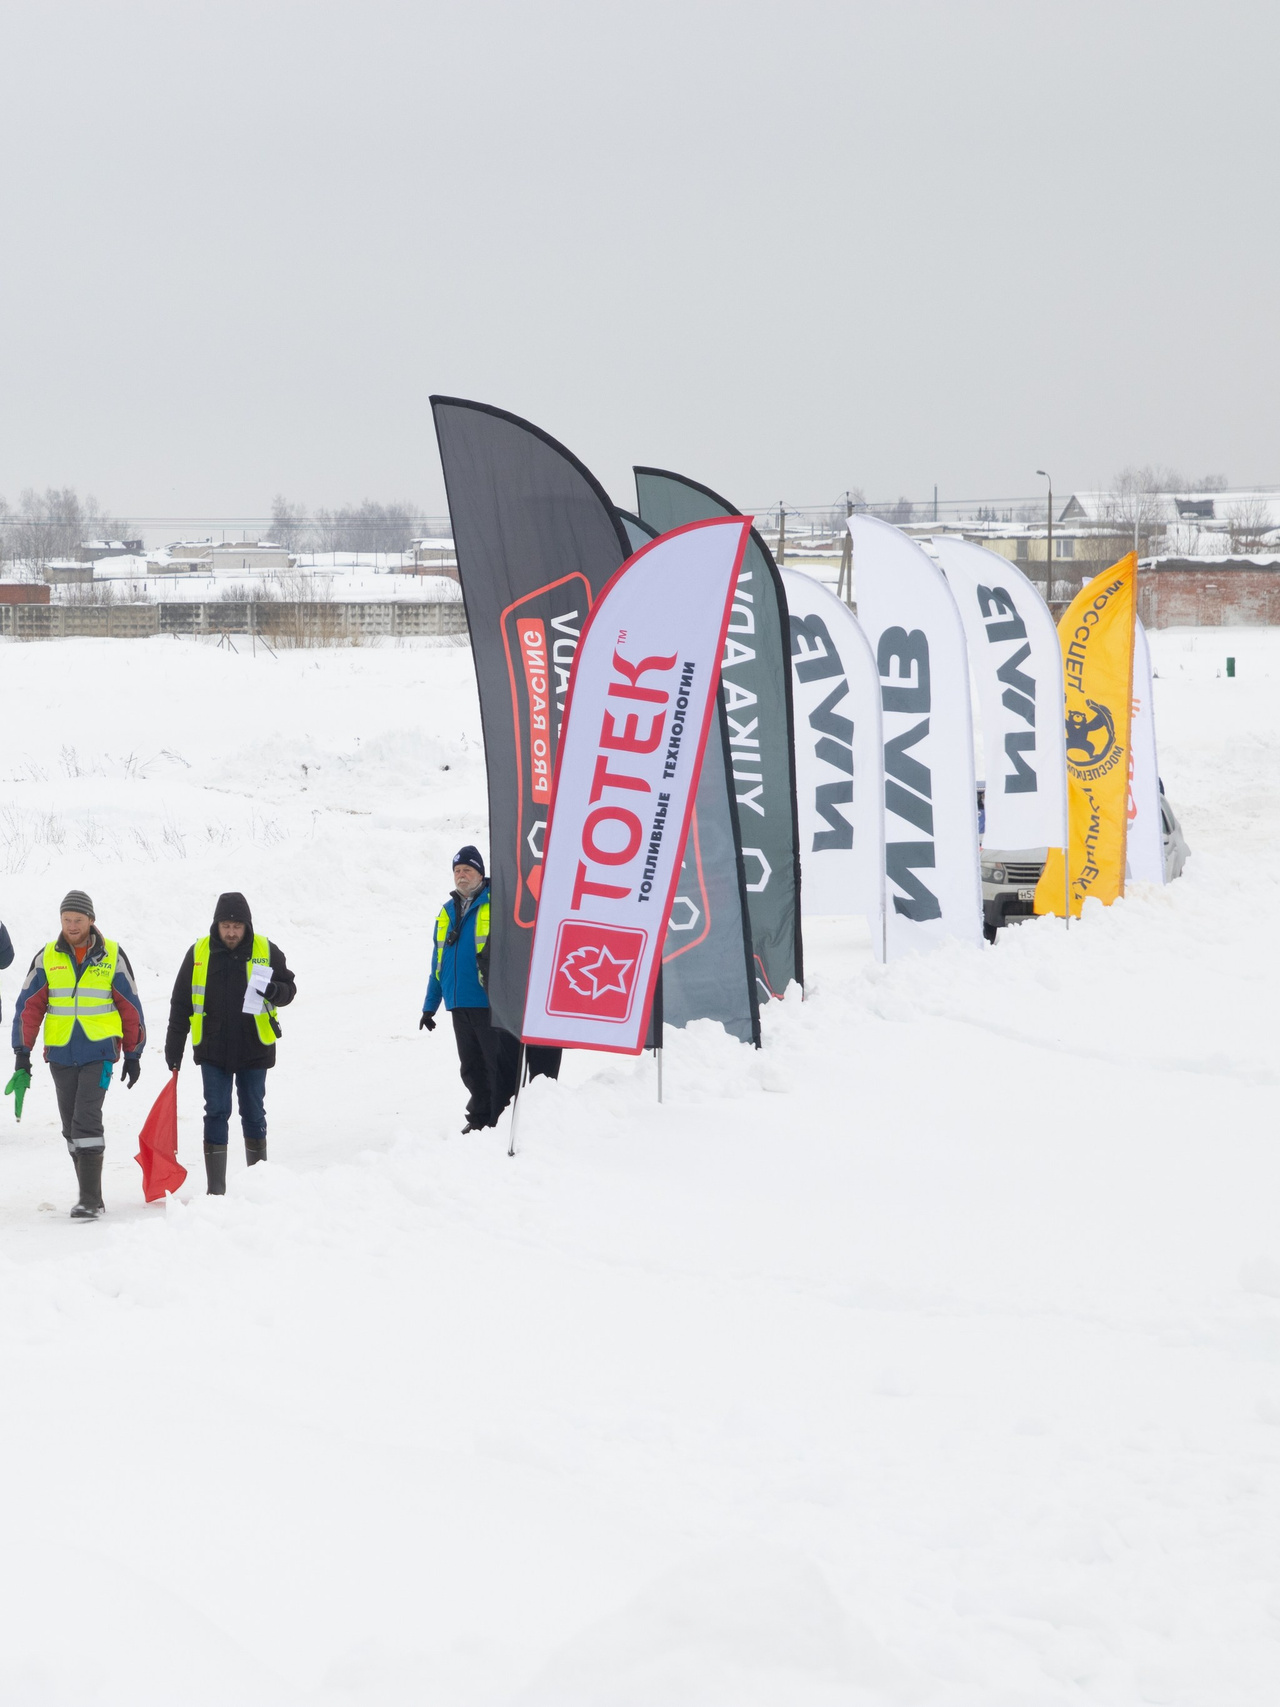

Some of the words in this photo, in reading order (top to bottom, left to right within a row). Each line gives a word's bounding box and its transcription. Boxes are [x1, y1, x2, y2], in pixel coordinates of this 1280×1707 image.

[570, 647, 678, 911] ТОТЕК
[638, 793, 671, 902] ТОПЛИВНЫЕ
[663, 661, 696, 779] ТЕХНОЛОГИИ
